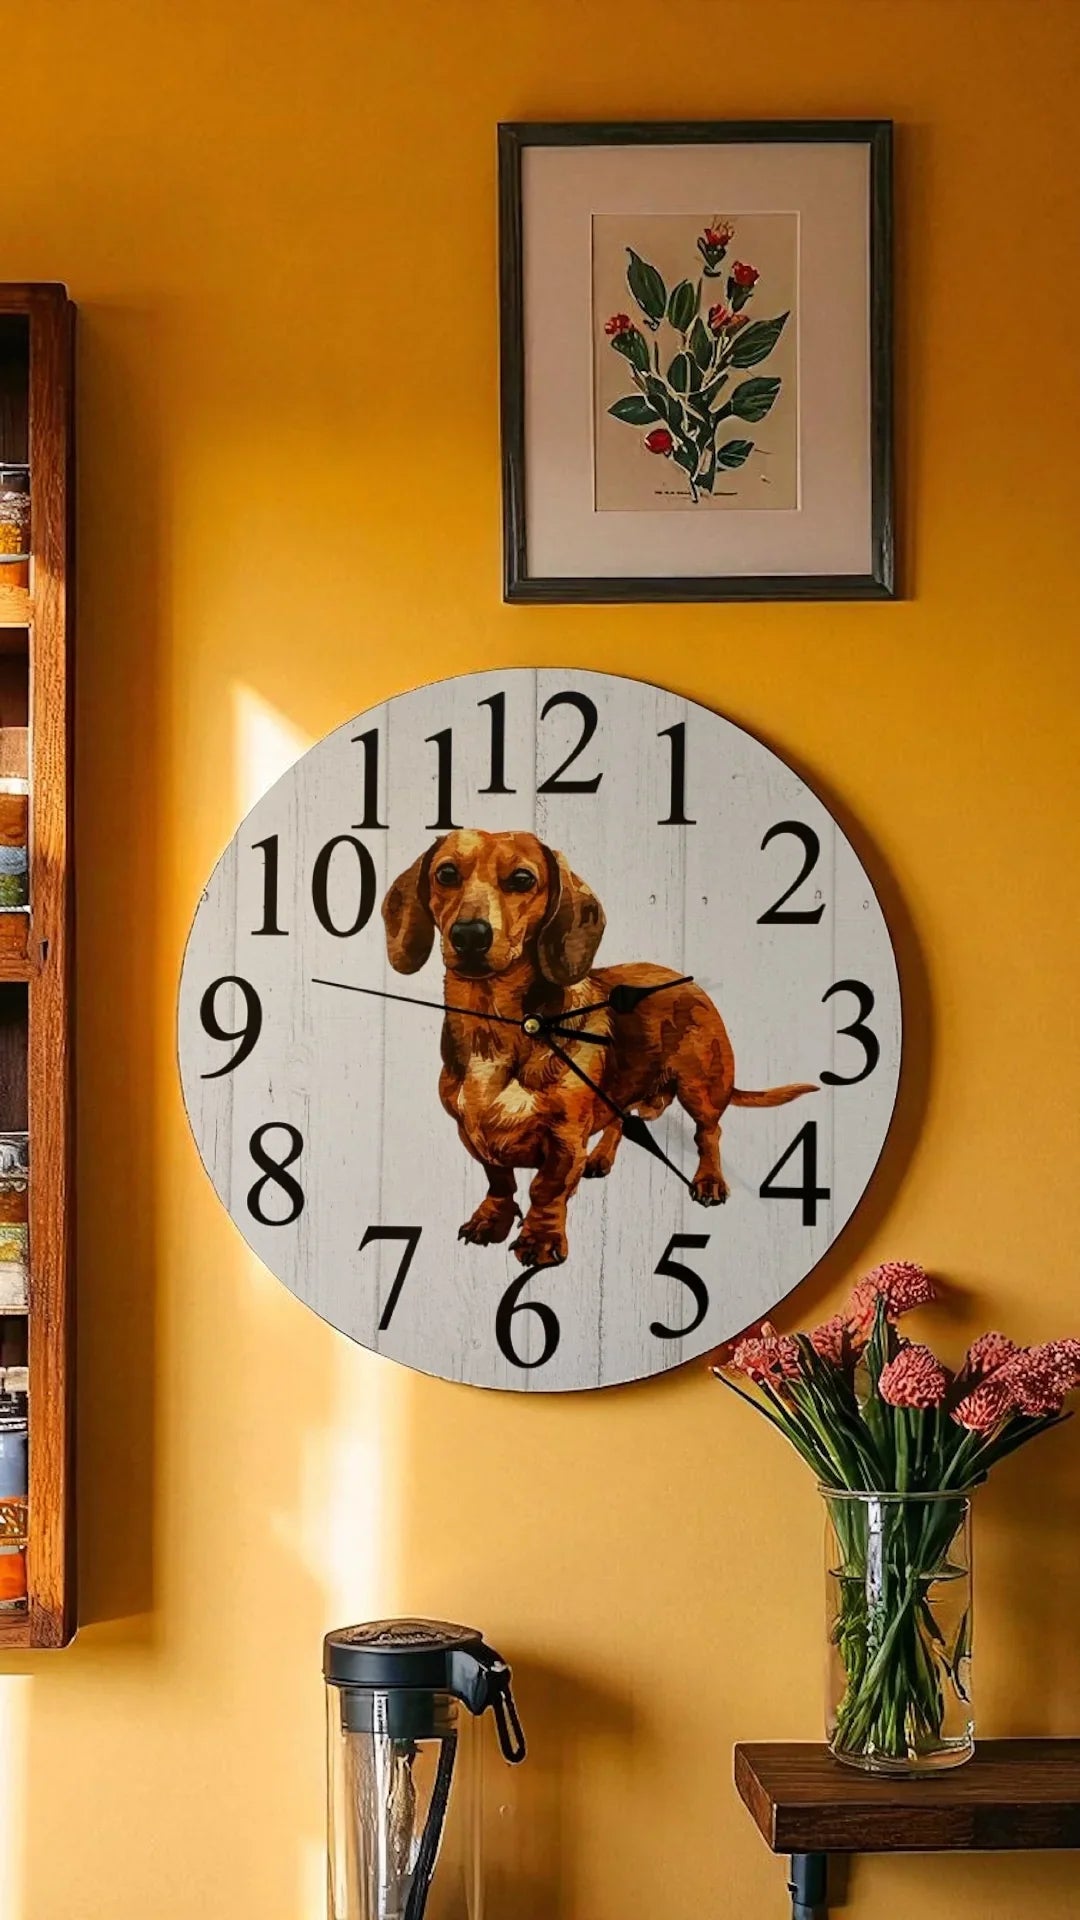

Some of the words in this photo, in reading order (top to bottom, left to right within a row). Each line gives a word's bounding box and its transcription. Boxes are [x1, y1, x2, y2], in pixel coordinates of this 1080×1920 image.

[351, 729, 464, 830] 11
[478, 692, 604, 794] 12
[657, 722, 696, 825] 1
[251, 835, 377, 938] 10
[757, 821, 826, 925] 2
[200, 976, 263, 1078] 9
[819, 980, 880, 1086] 3
[246, 1122, 305, 1227] 8
[760, 1121, 831, 1227] 4
[359, 1226, 422, 1331] 7
[496, 1265, 562, 1369] 6
[650, 1233, 711, 1340] 5
